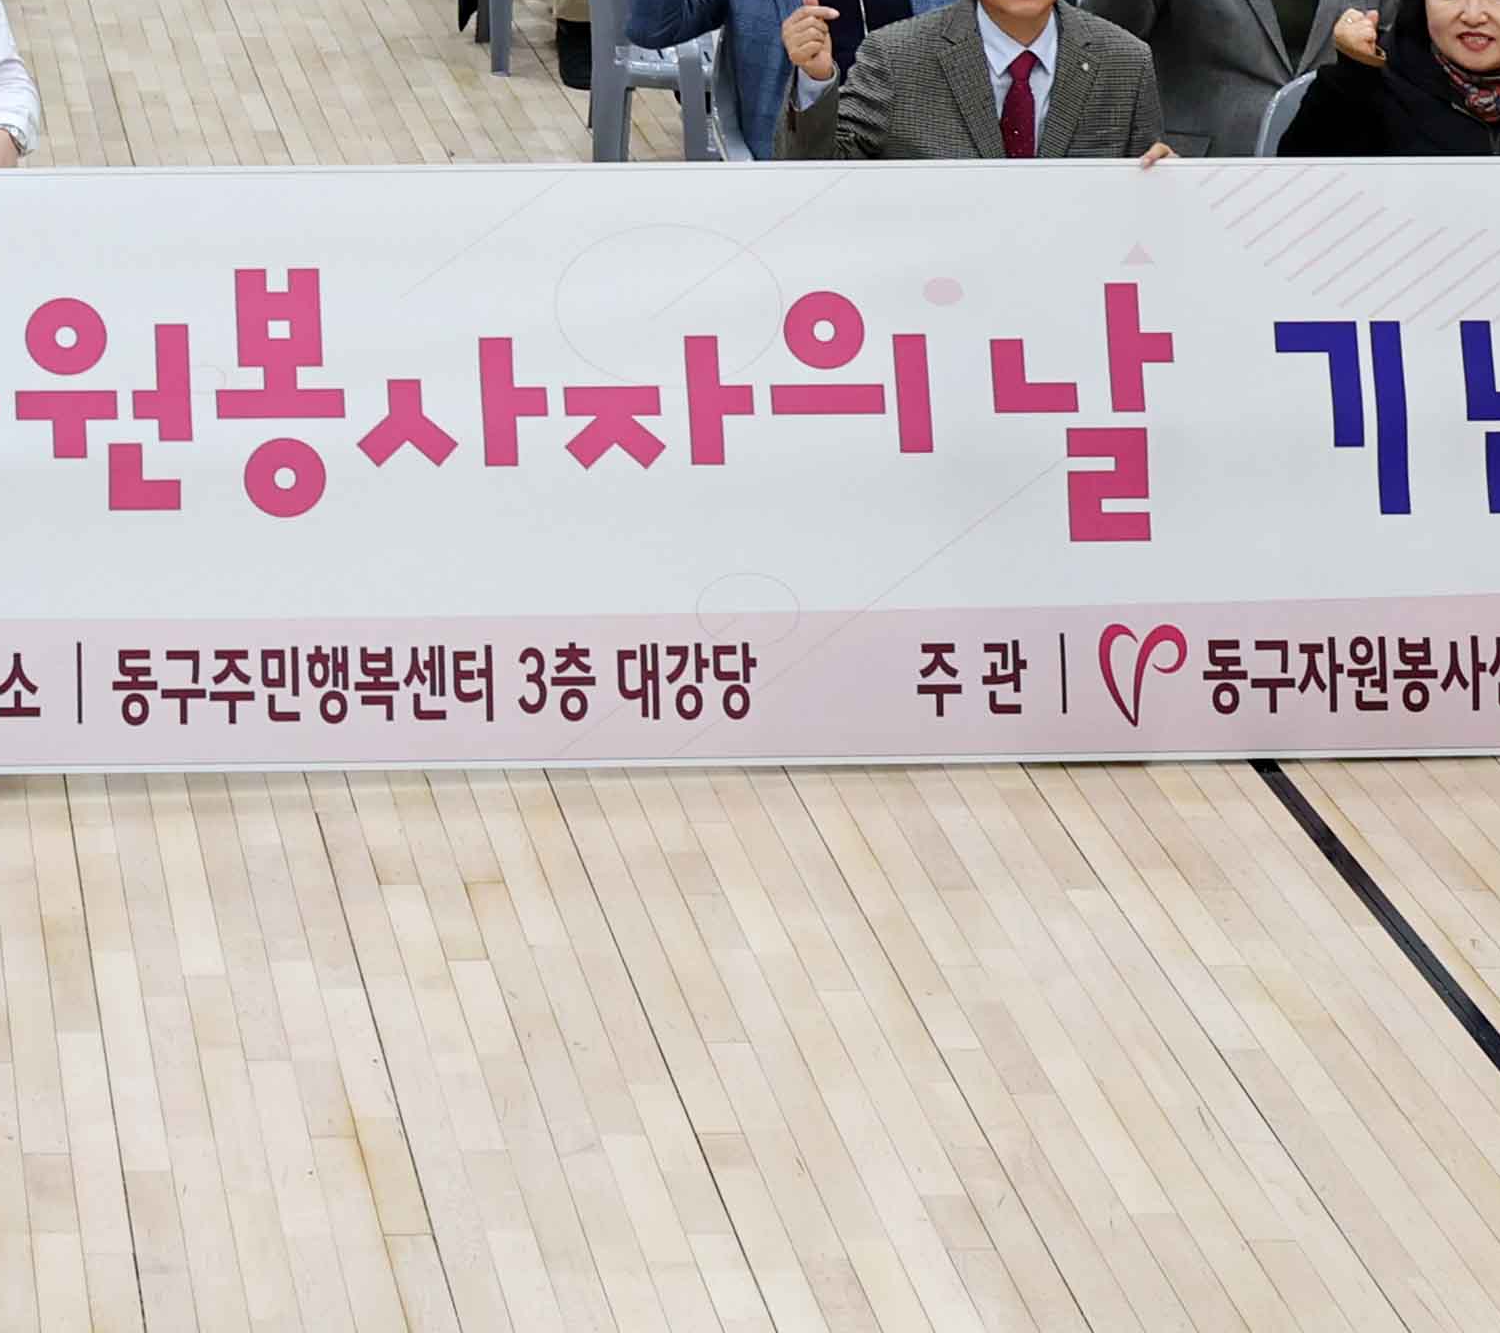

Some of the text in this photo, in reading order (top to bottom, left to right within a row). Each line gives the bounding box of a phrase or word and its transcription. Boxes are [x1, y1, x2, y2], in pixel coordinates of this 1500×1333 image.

[990, 283, 1173, 542] 날
[111, 644, 494, 727] 동구주민행복센터
[517, 641, 597, 722] 3층
[616, 641, 758, 721] 대강당
